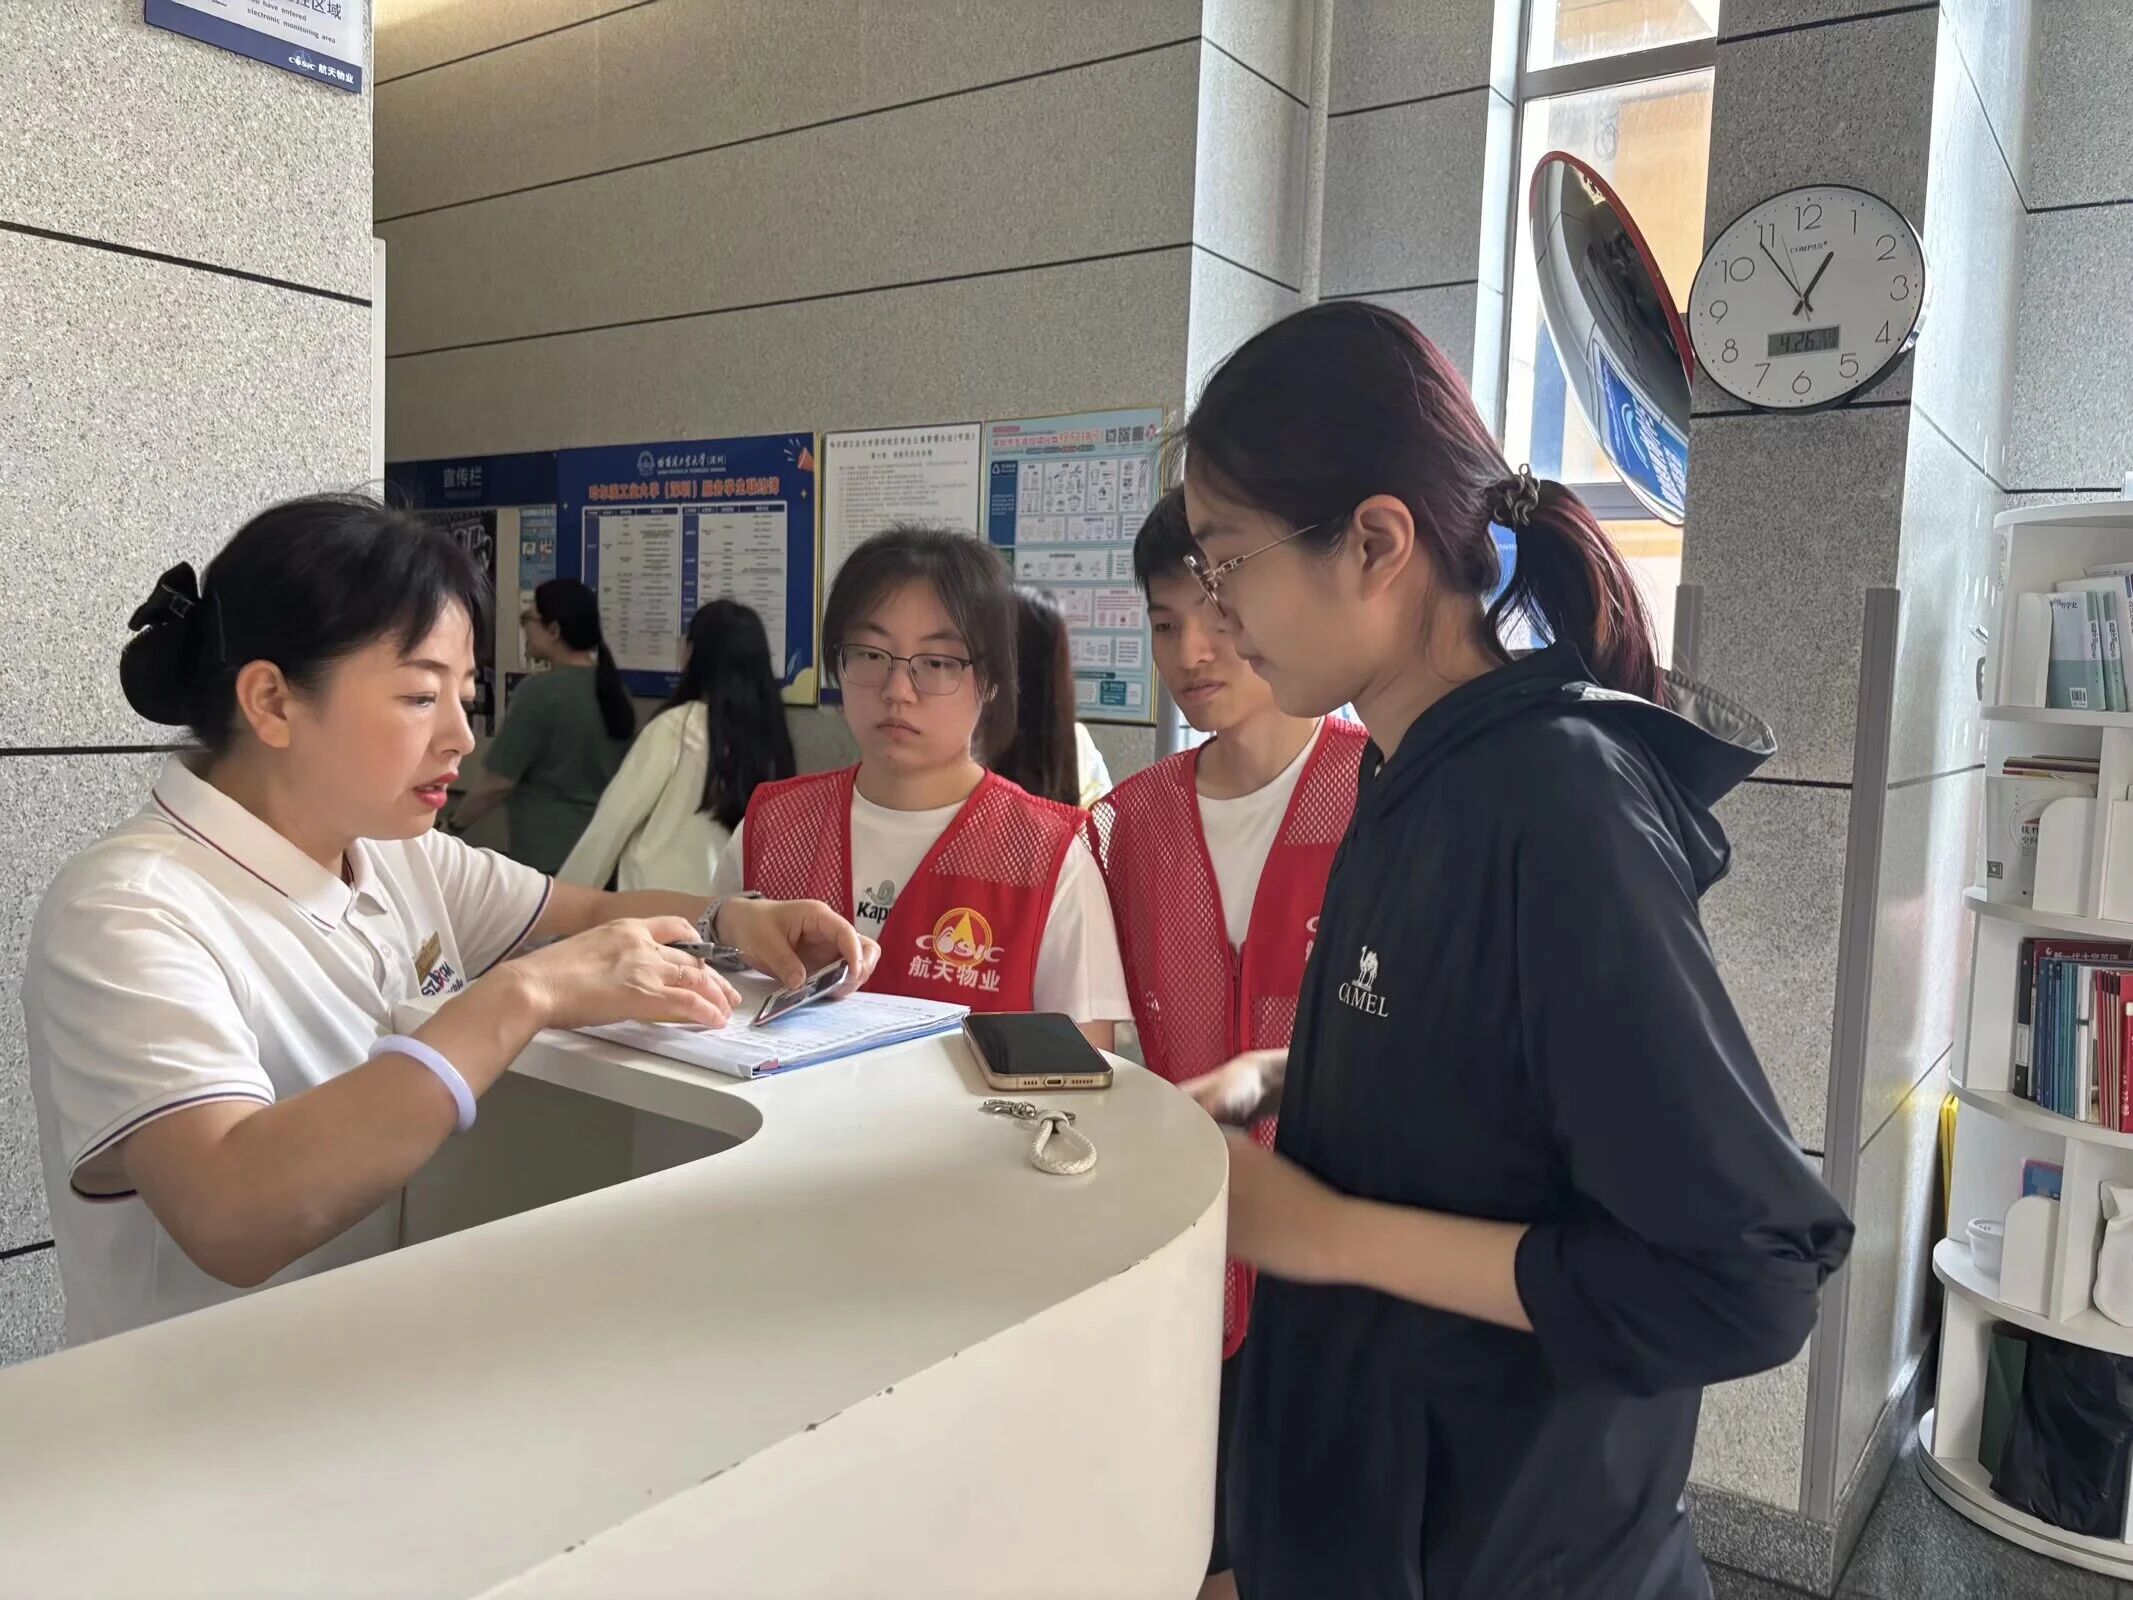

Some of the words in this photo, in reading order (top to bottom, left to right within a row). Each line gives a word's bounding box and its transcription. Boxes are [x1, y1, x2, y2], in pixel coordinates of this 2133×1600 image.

[247, 8, 281, 25] electronic
[283, 20, 320, 40] monitoring
[321, 34, 336, 44] area
[281, 8, 307, 21] entered
[318, 63, 354, 84] 航天物业
[1795, 203, 1823, 231] 12
[1850, 209, 1857, 235] 1
[1757, 223, 1775, 248] 11
[1875, 234, 1896, 261] 2
[1721, 256, 1755, 283] 10
[1890, 274, 1909, 301] 3
[1709, 300, 1728, 324] 9
[1875, 320, 1892, 345] 4
[1721, 338, 1739, 364] 8
[1754, 362, 1771, 388] 7
[1839, 352, 1859, 378] 5
[1791, 370, 1812, 395] 6
[442, 464, 483, 488] 宣传栏
[856, 901, 892, 925] Kap
[908, 954, 1001, 992] 航天物业
[1338, 982, 1389, 1018] CAMEL
